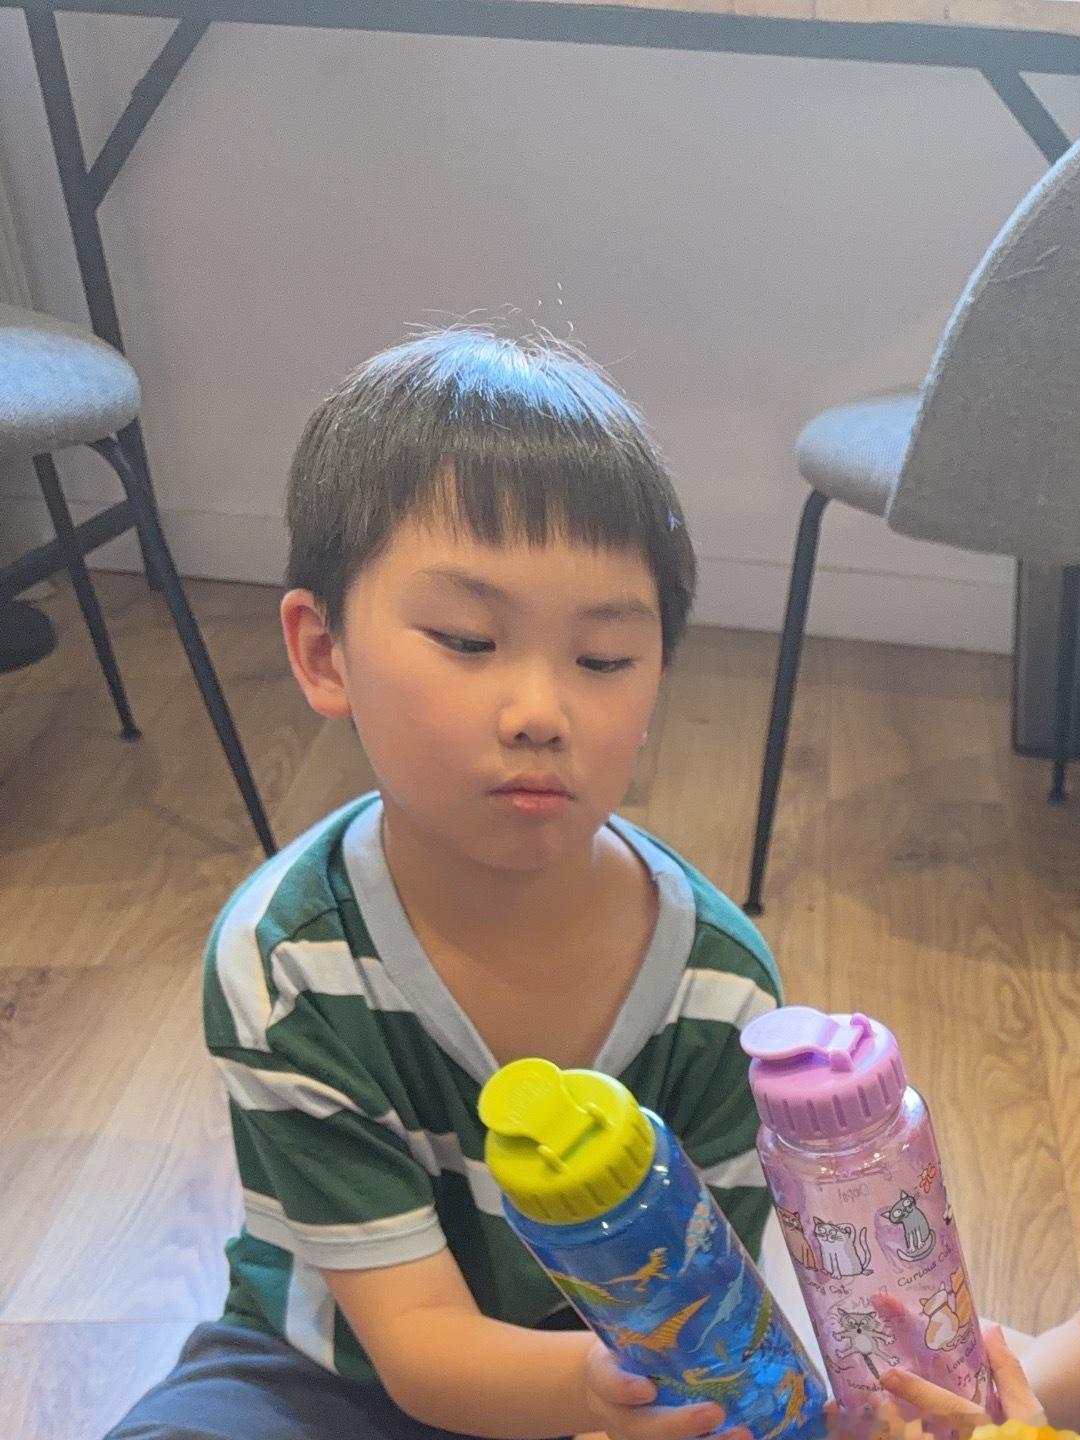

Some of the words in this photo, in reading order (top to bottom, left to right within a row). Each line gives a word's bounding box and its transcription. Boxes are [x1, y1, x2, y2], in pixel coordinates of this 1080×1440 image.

[897, 1261, 937, 1287] Curious
[828, 1284, 849, 1295] Cat
[945, 1356, 966, 1374] Love
